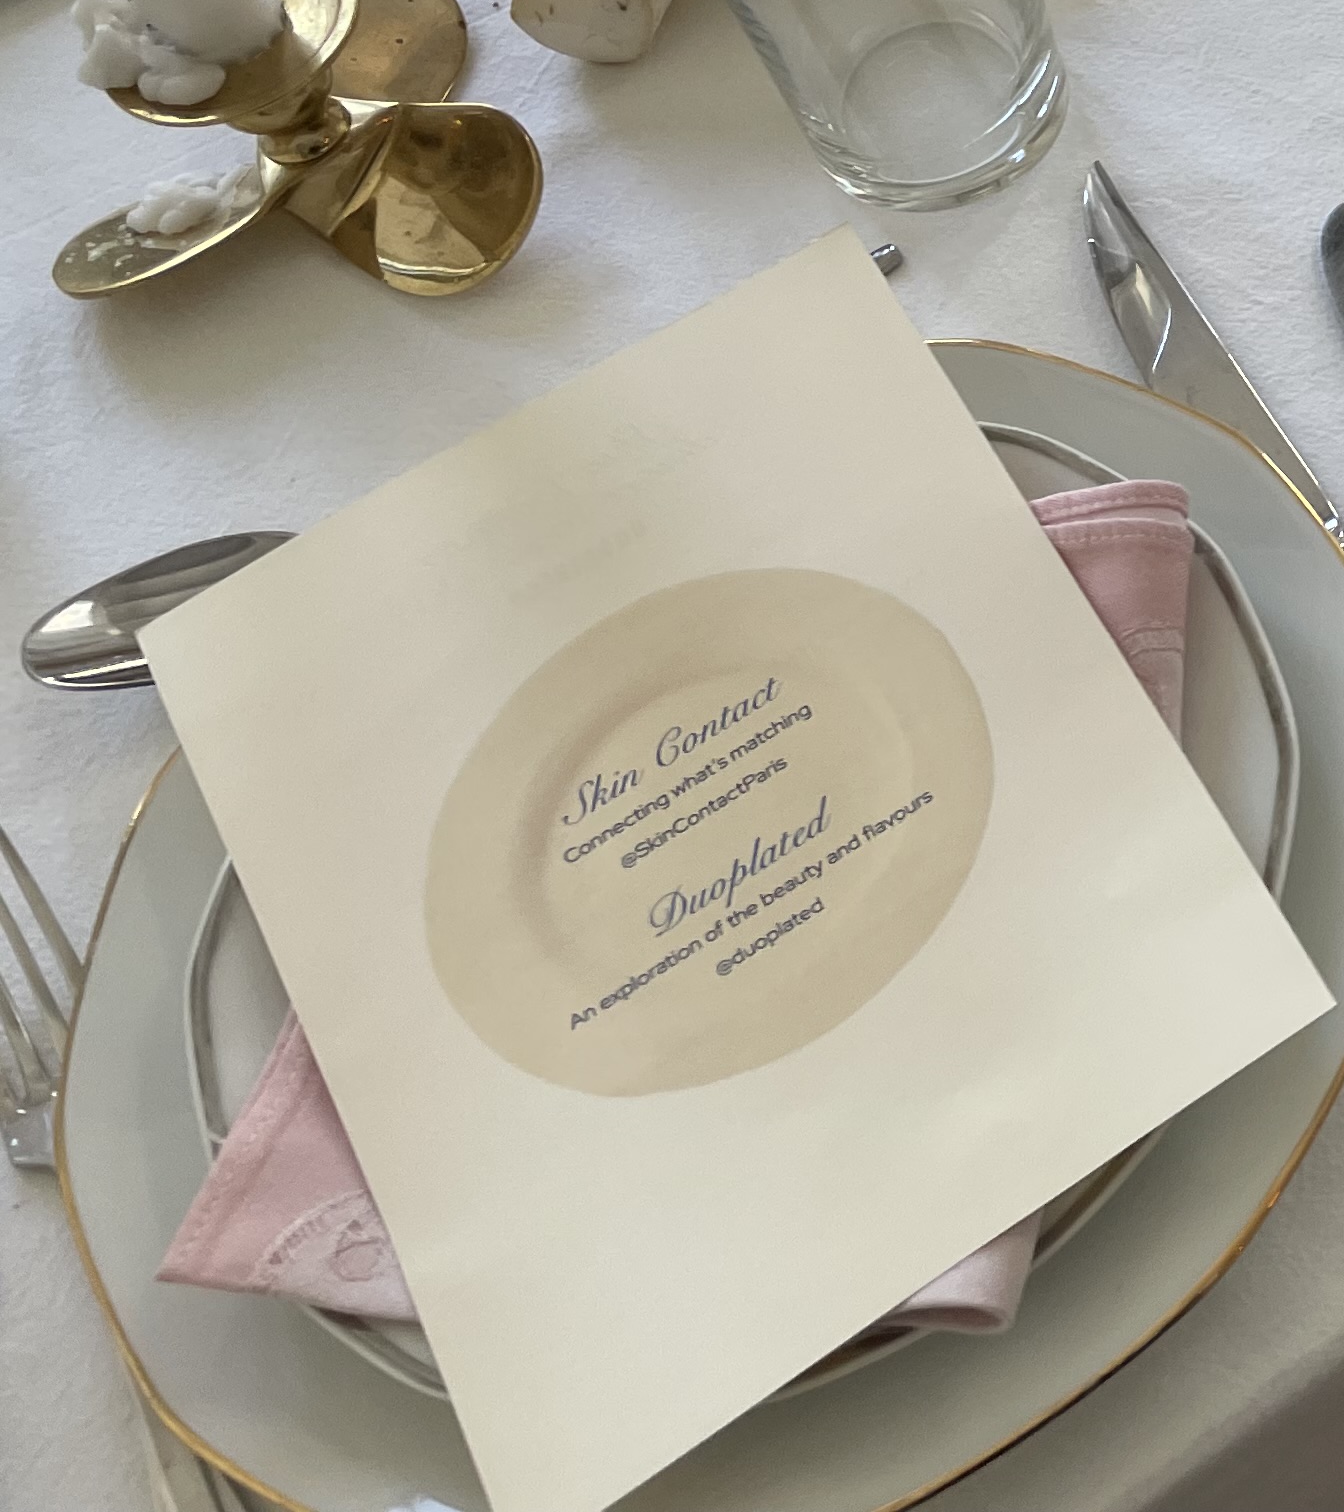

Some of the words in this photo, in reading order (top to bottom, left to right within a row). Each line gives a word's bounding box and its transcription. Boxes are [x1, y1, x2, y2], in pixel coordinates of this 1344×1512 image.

[561, 769, 643, 825] Skin
[656, 677, 783, 767] Contact
[563, 794, 671, 863] Connecting
[669, 758, 729, 798] what's
[729, 705, 813, 762] matching
[621, 758, 788, 868] @SkinContactParis
[571, 1007, 597, 1030] An
[599, 940, 704, 1010] exploration
[704, 920, 724, 942] of
[726, 904, 758, 928] the
[759, 861, 822, 907] beauty
[828, 834, 862, 864] and
[864, 791, 934, 841] flavours
[649, 795, 831, 937] Duoplated
[716, 897, 825, 976] @duoplated
